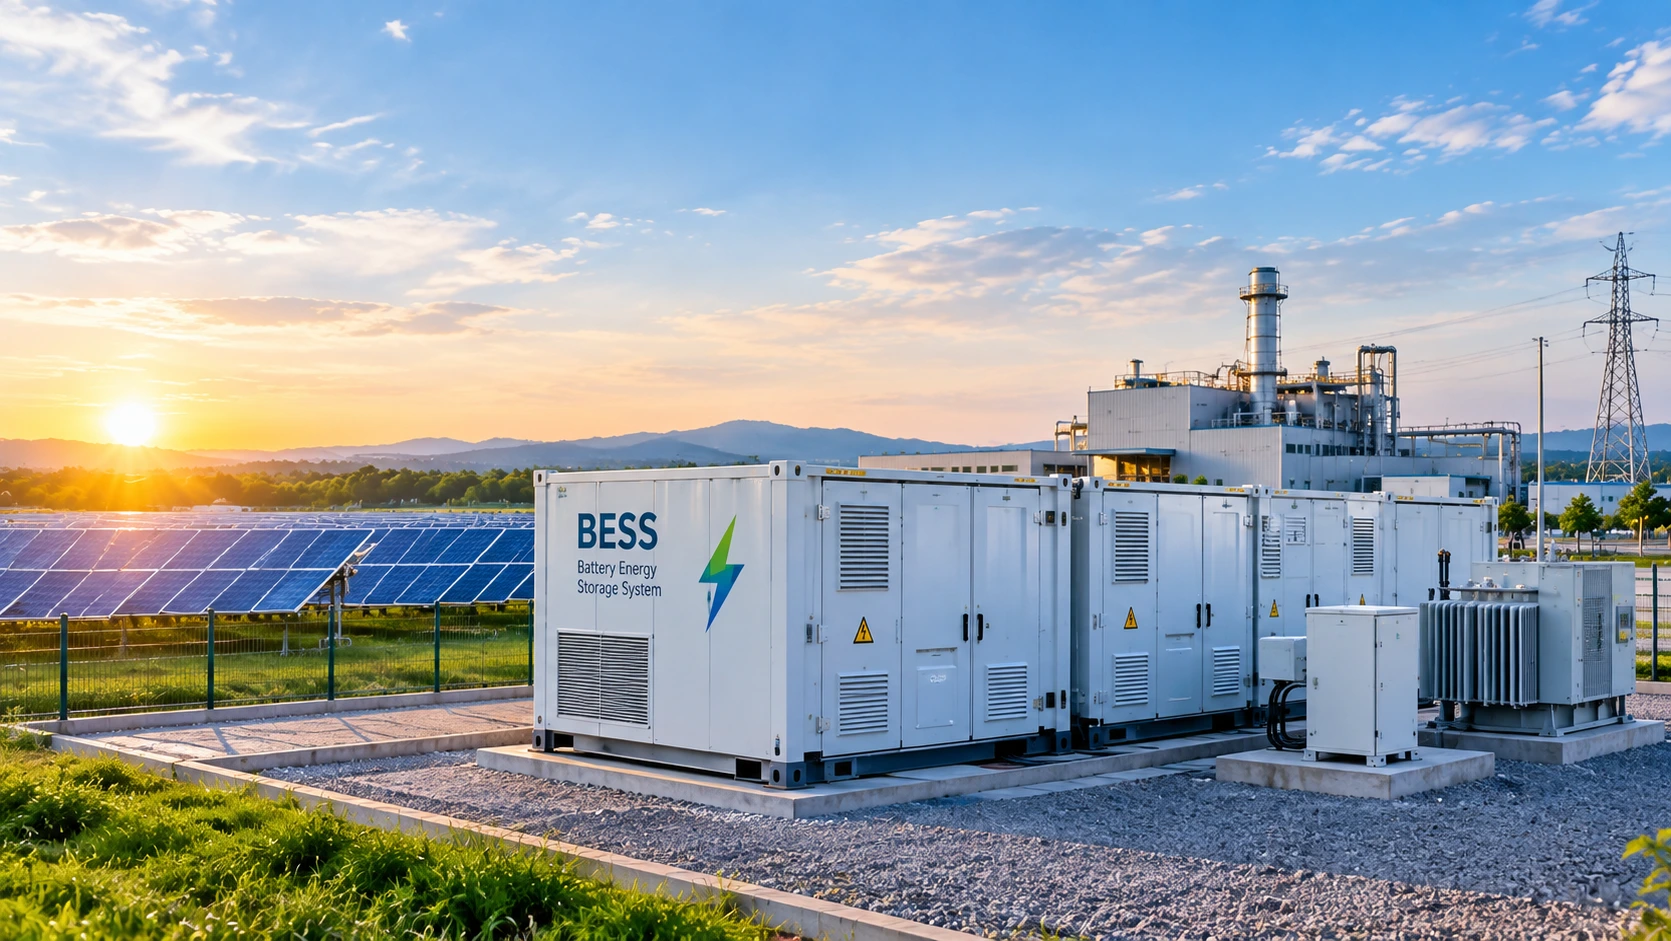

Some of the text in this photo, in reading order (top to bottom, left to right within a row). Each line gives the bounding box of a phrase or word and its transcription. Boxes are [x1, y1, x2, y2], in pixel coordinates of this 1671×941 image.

[577, 512, 658, 550] BESS
[577, 559, 657, 580] Battery Energy
[577, 579, 662, 599] Storage System
